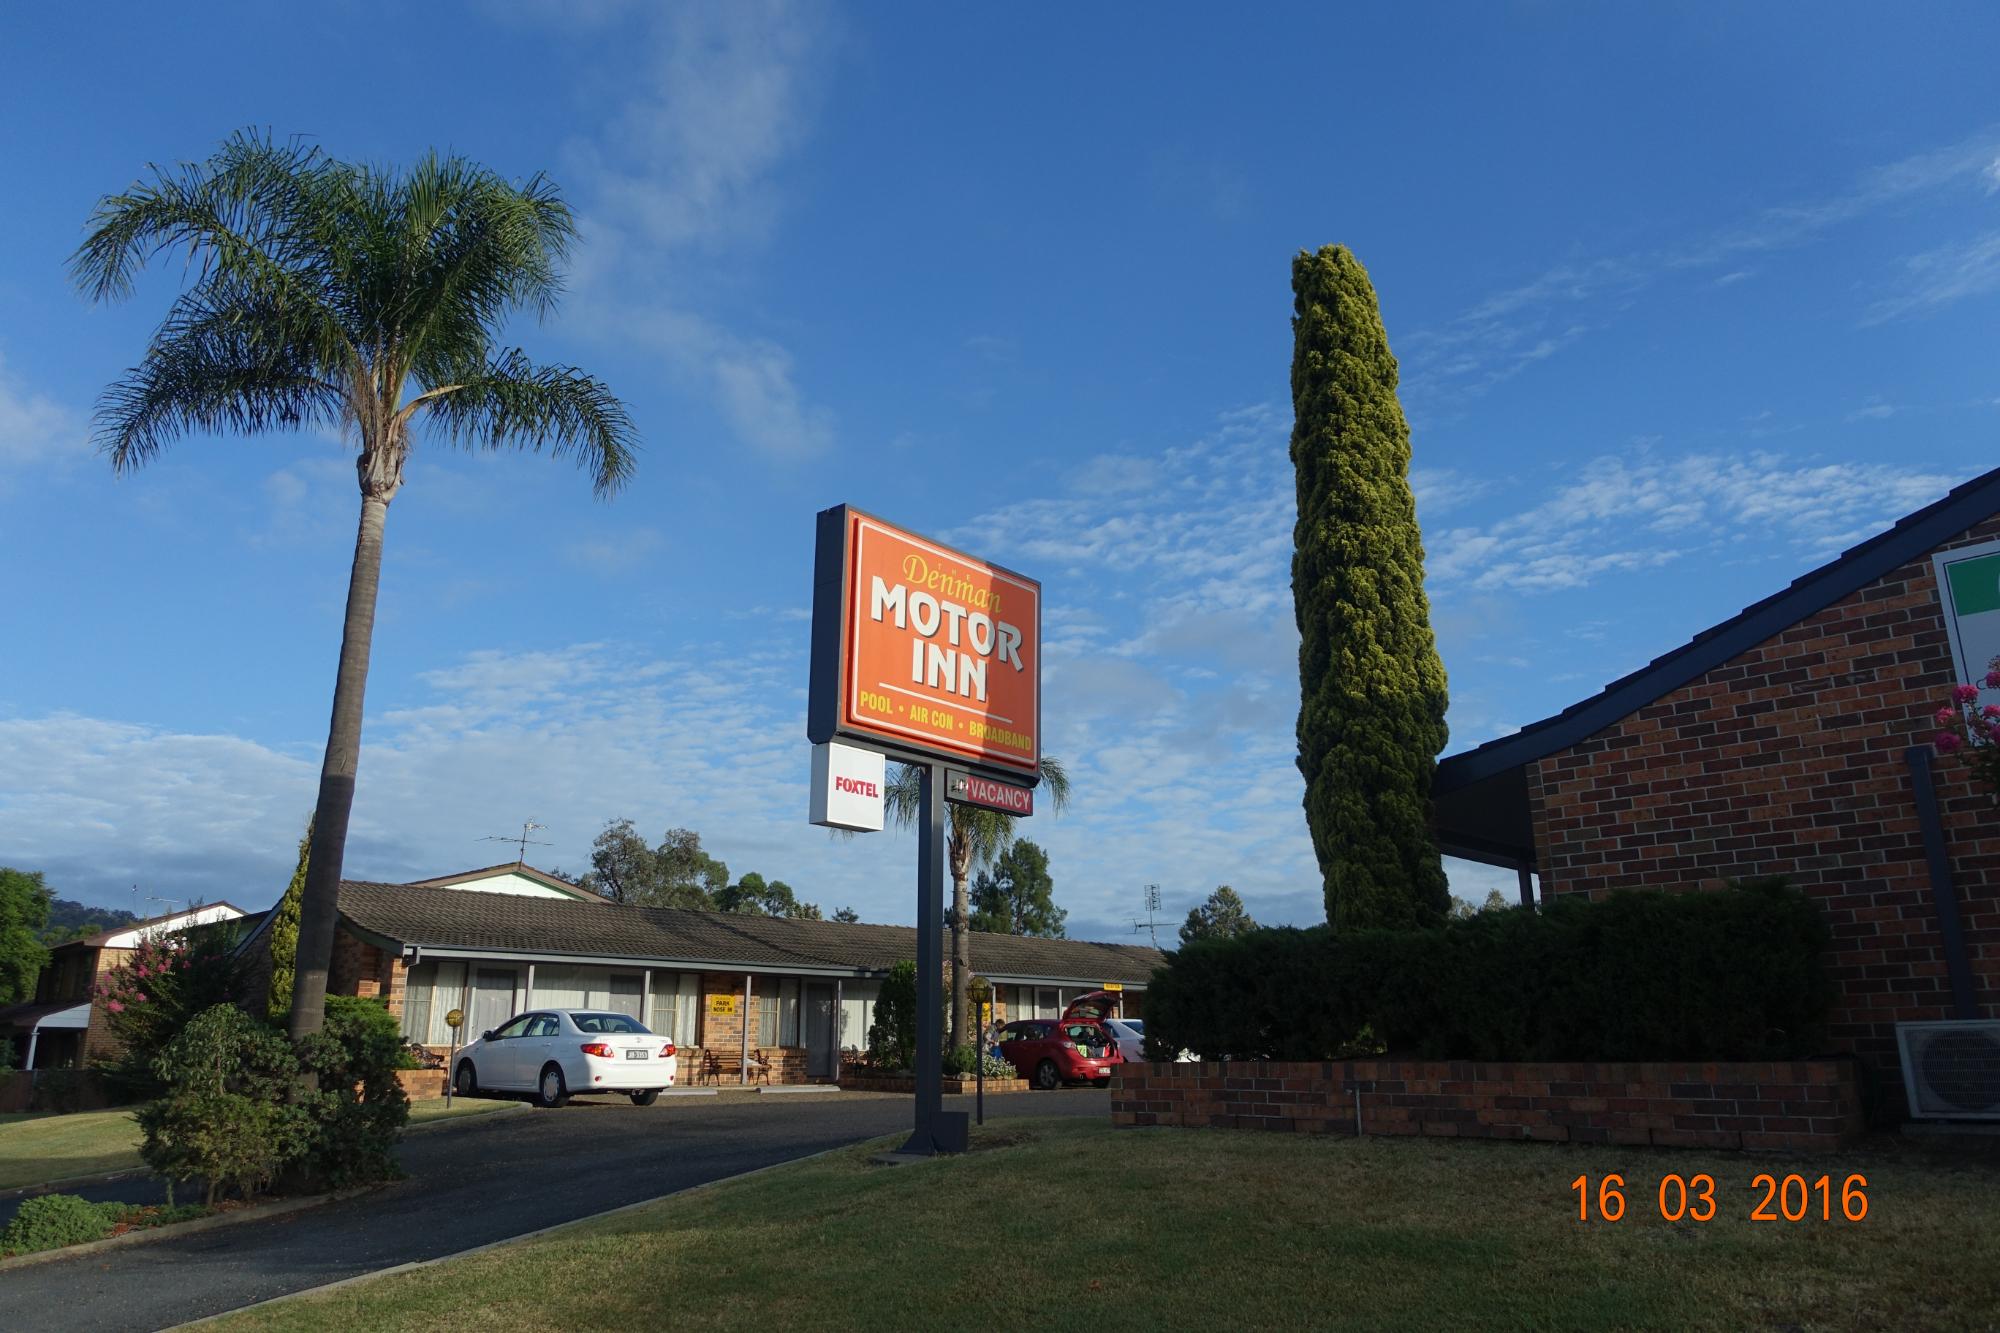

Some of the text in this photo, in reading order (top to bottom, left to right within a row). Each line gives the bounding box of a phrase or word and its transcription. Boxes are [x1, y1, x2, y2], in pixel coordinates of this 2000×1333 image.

[903, 554, 1002, 613] Denman
[871, 575, 1024, 672] MOTOR
[912, 638, 986, 703] INN
[860, 690, 1032, 751] POOL AIR CON BROADBAND
[835, 776, 878, 799] FOXTEL
[970, 779, 1030, 810] VACANCY
